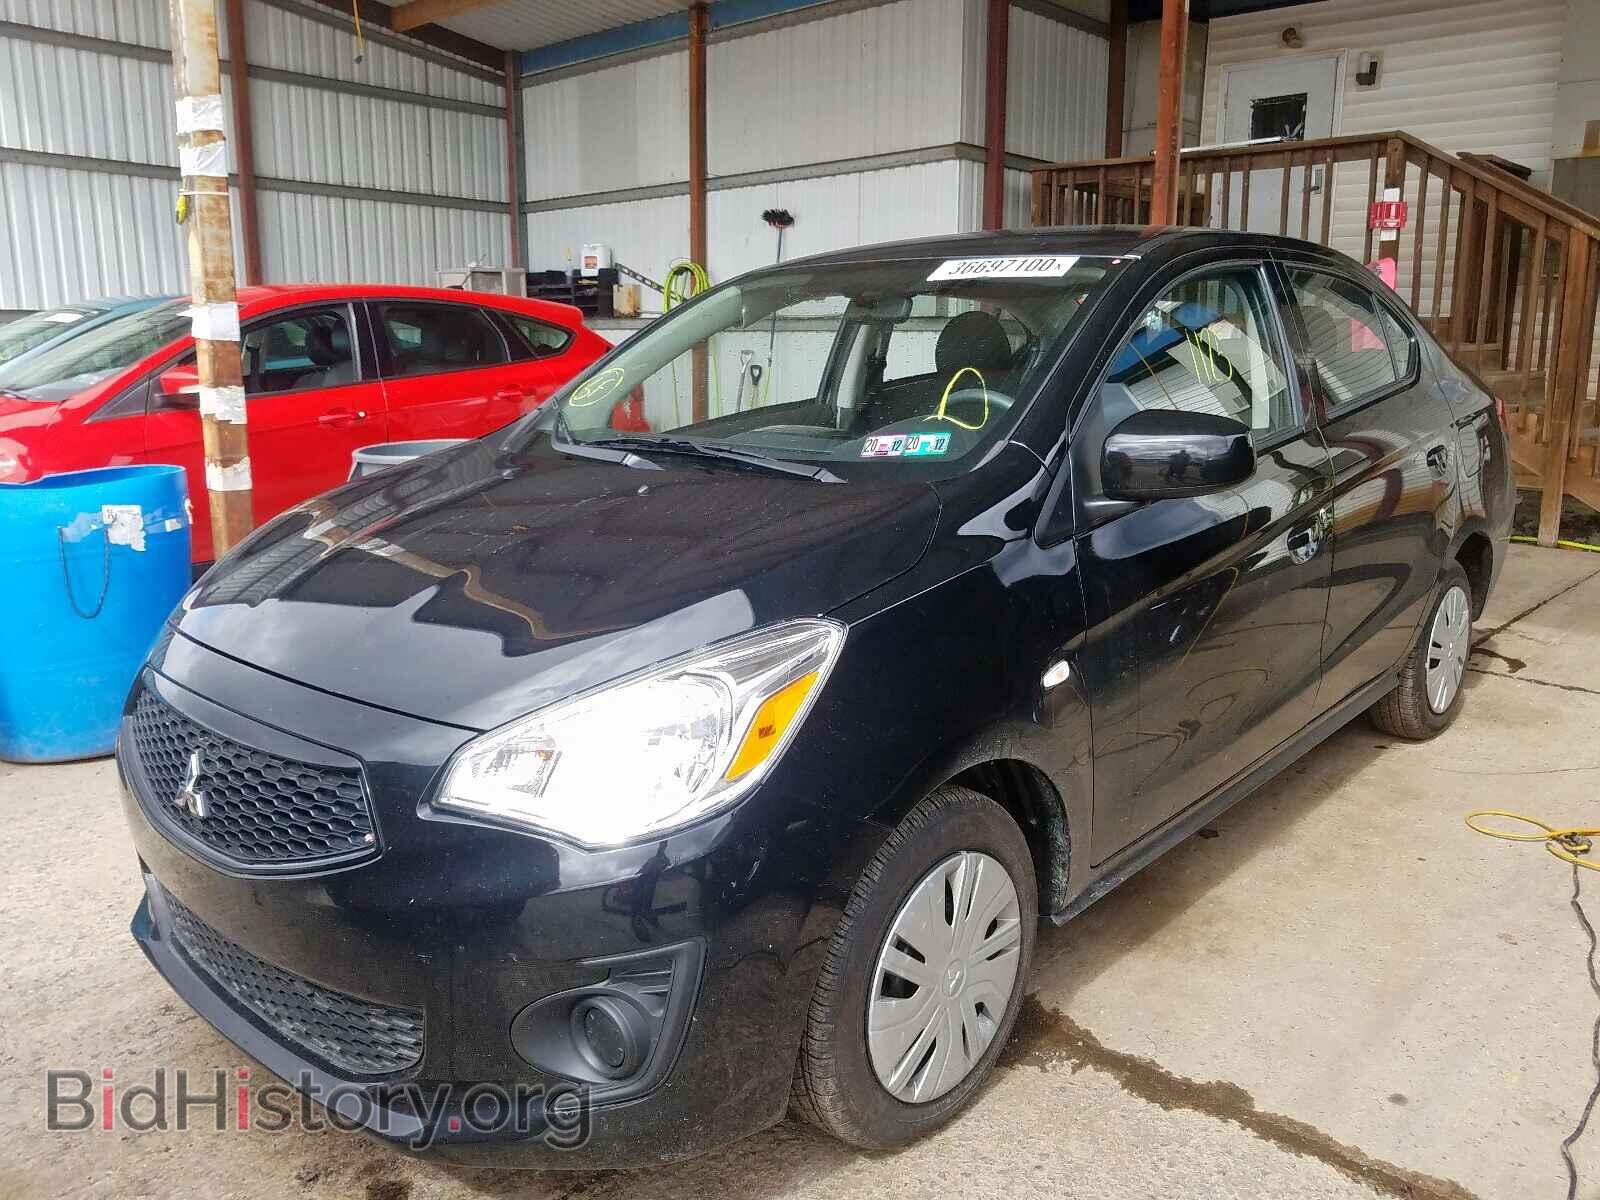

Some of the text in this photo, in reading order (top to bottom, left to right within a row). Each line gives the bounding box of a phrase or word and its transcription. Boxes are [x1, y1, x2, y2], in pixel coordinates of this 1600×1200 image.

[947, 258, 1057, 275] 36697100
[863, 438, 879, 453] 20
[891, 439, 903, 452] 12
[904, 436, 946, 451] 20 12
